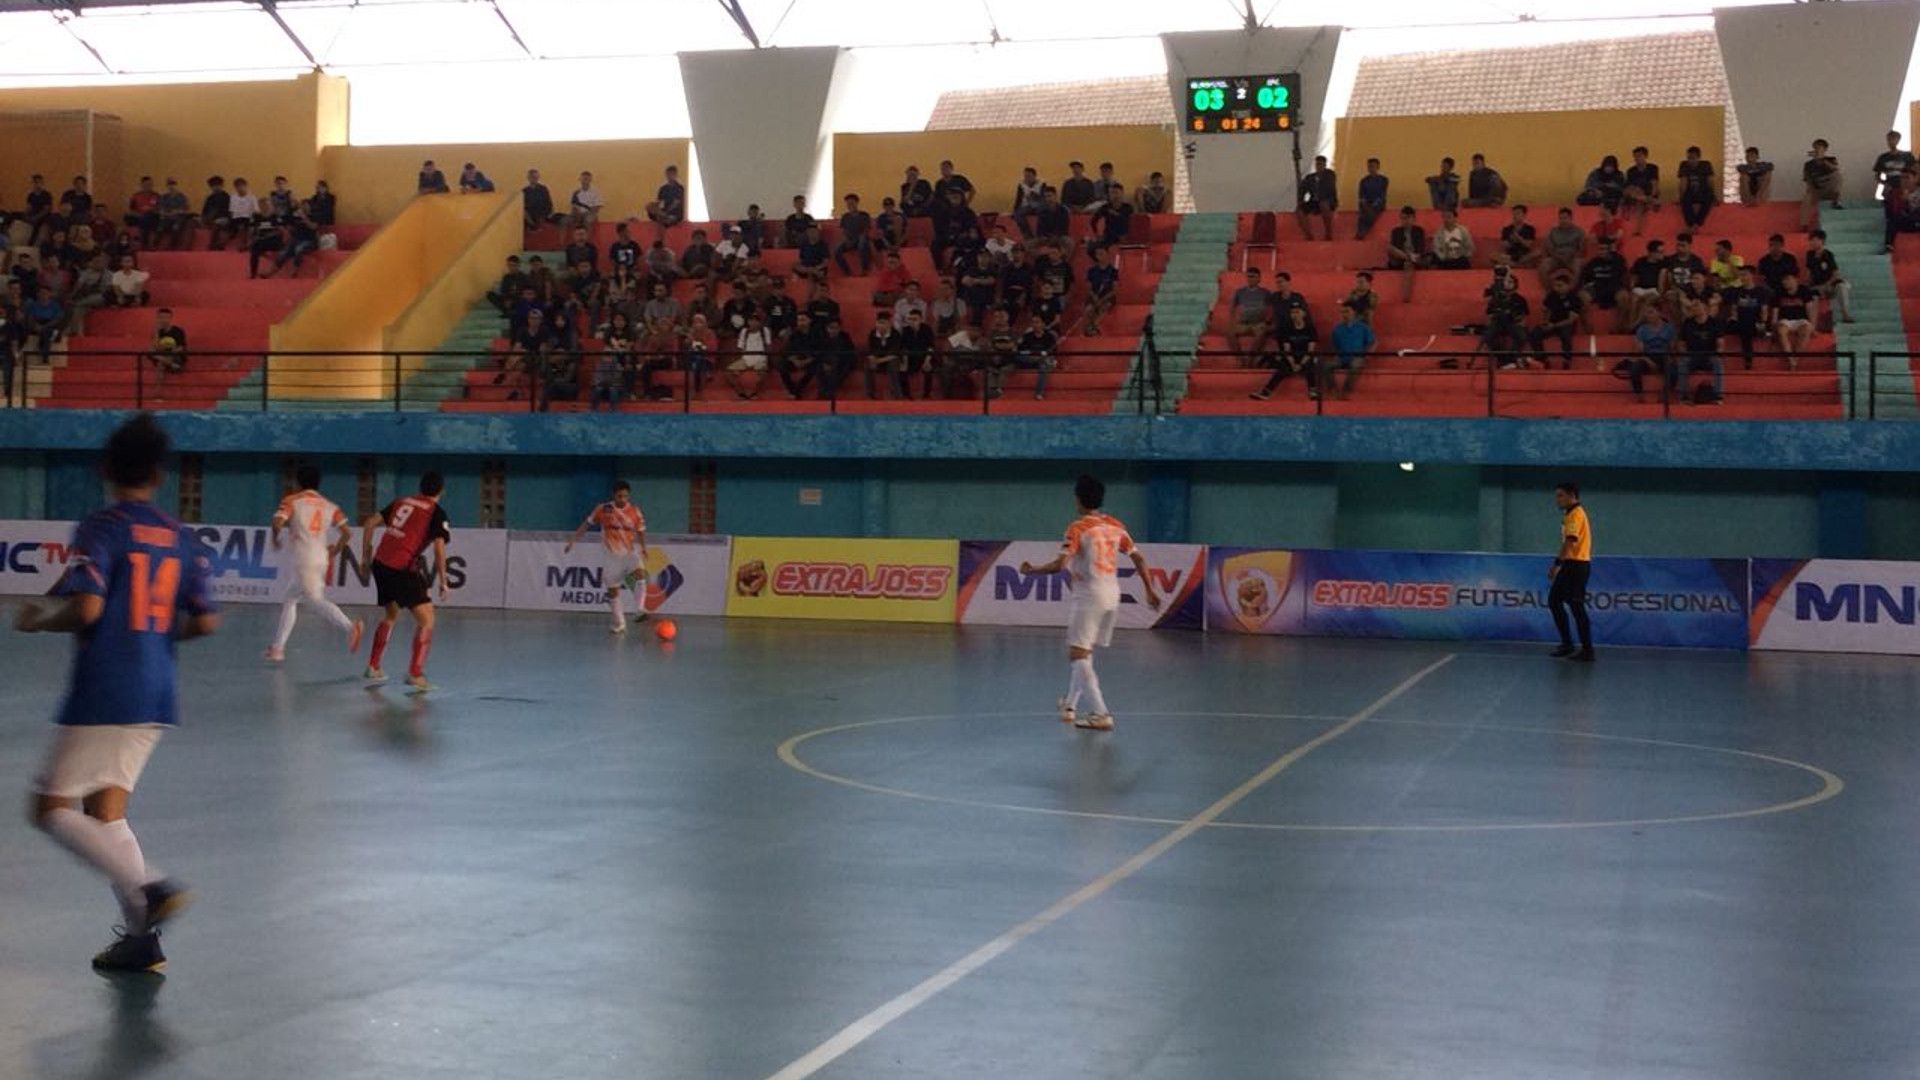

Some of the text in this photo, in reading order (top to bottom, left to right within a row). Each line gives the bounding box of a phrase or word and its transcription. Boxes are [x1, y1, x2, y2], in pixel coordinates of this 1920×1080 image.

[1194, 90, 1225, 111] 03
[1236, 88, 1247, 99] 2
[1257, 87, 1288, 109] 02
[309, 508, 322, 535] 4
[392, 504, 415, 528] 9
[128, 551, 181, 633] 14
[561, 591, 611, 604] MEDIA
[1584, 592, 1740, 614] ROFESIONAL
[1795, 582, 1920, 625] MN
